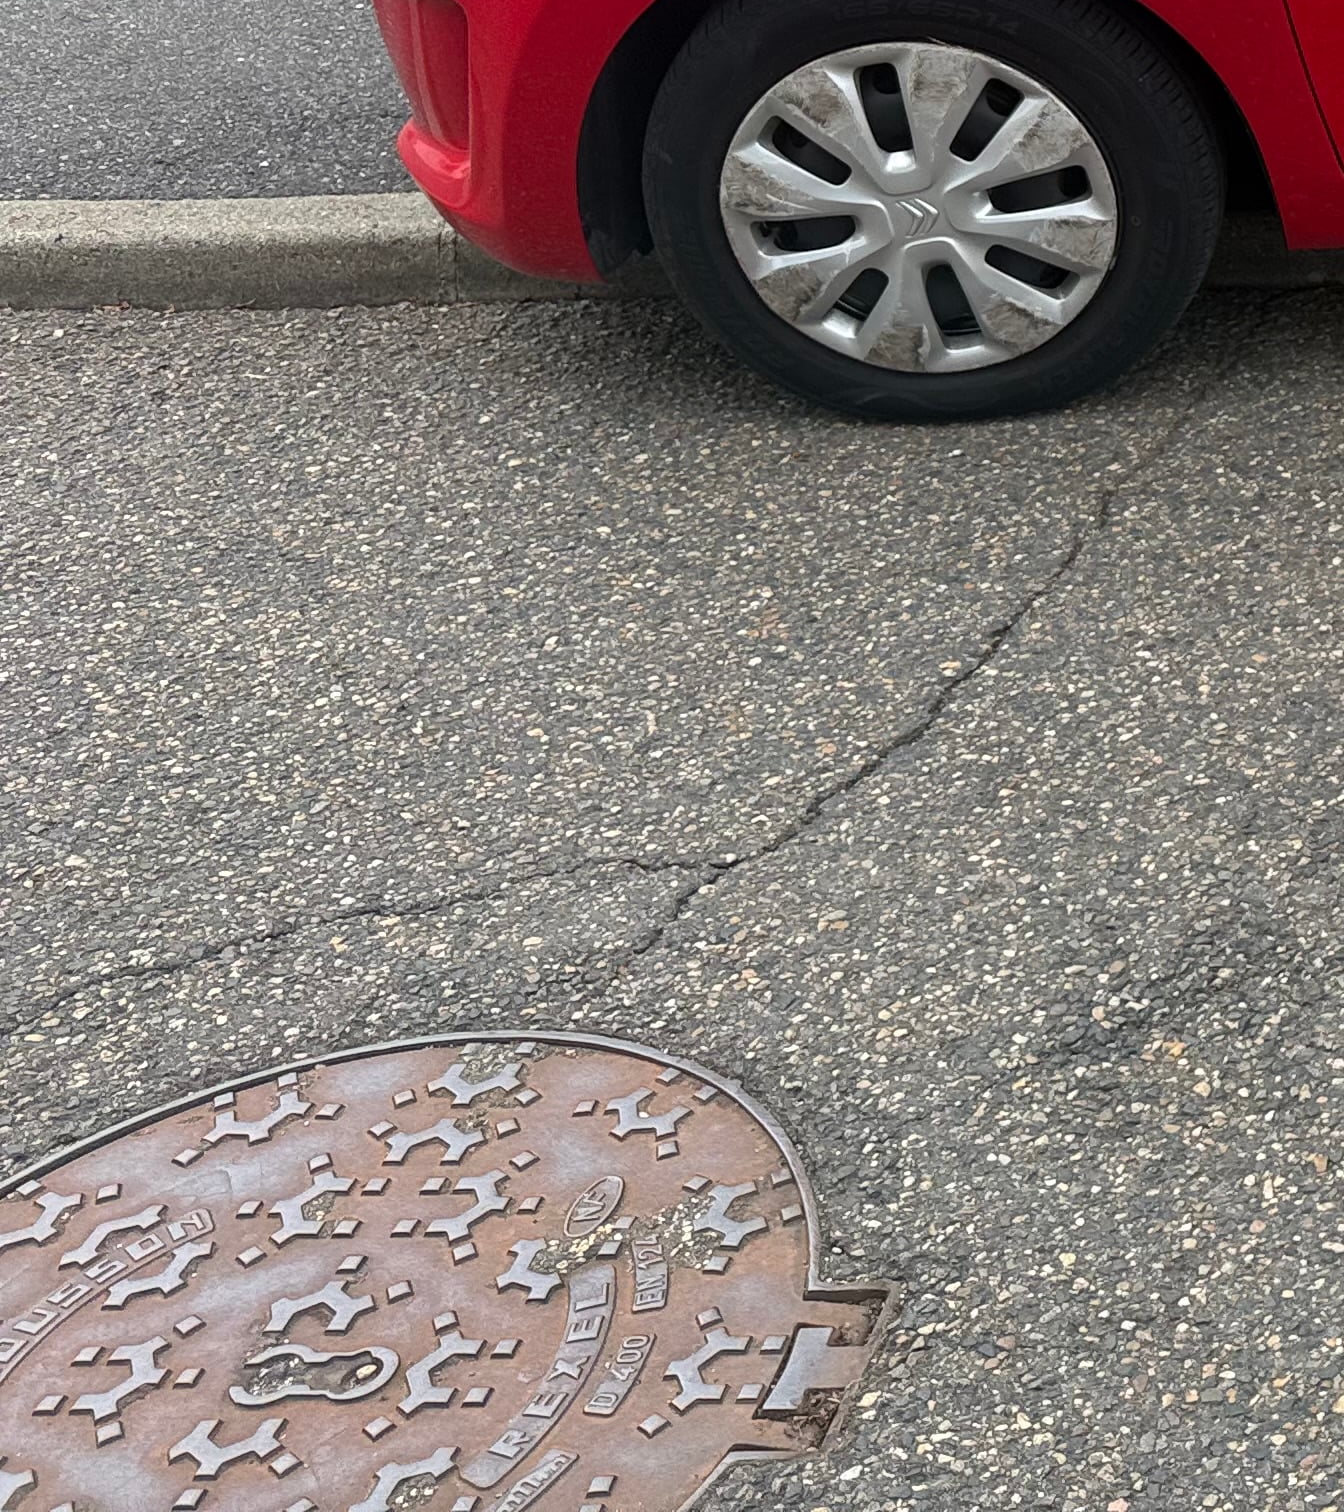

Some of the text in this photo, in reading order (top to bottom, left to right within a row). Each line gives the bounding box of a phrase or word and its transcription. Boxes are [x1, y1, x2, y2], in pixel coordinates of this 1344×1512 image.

[635, 1273, 666, 1307] EN
[488, 1281, 611, 1460] REXEL
[611, 1334, 650, 1384] 400
